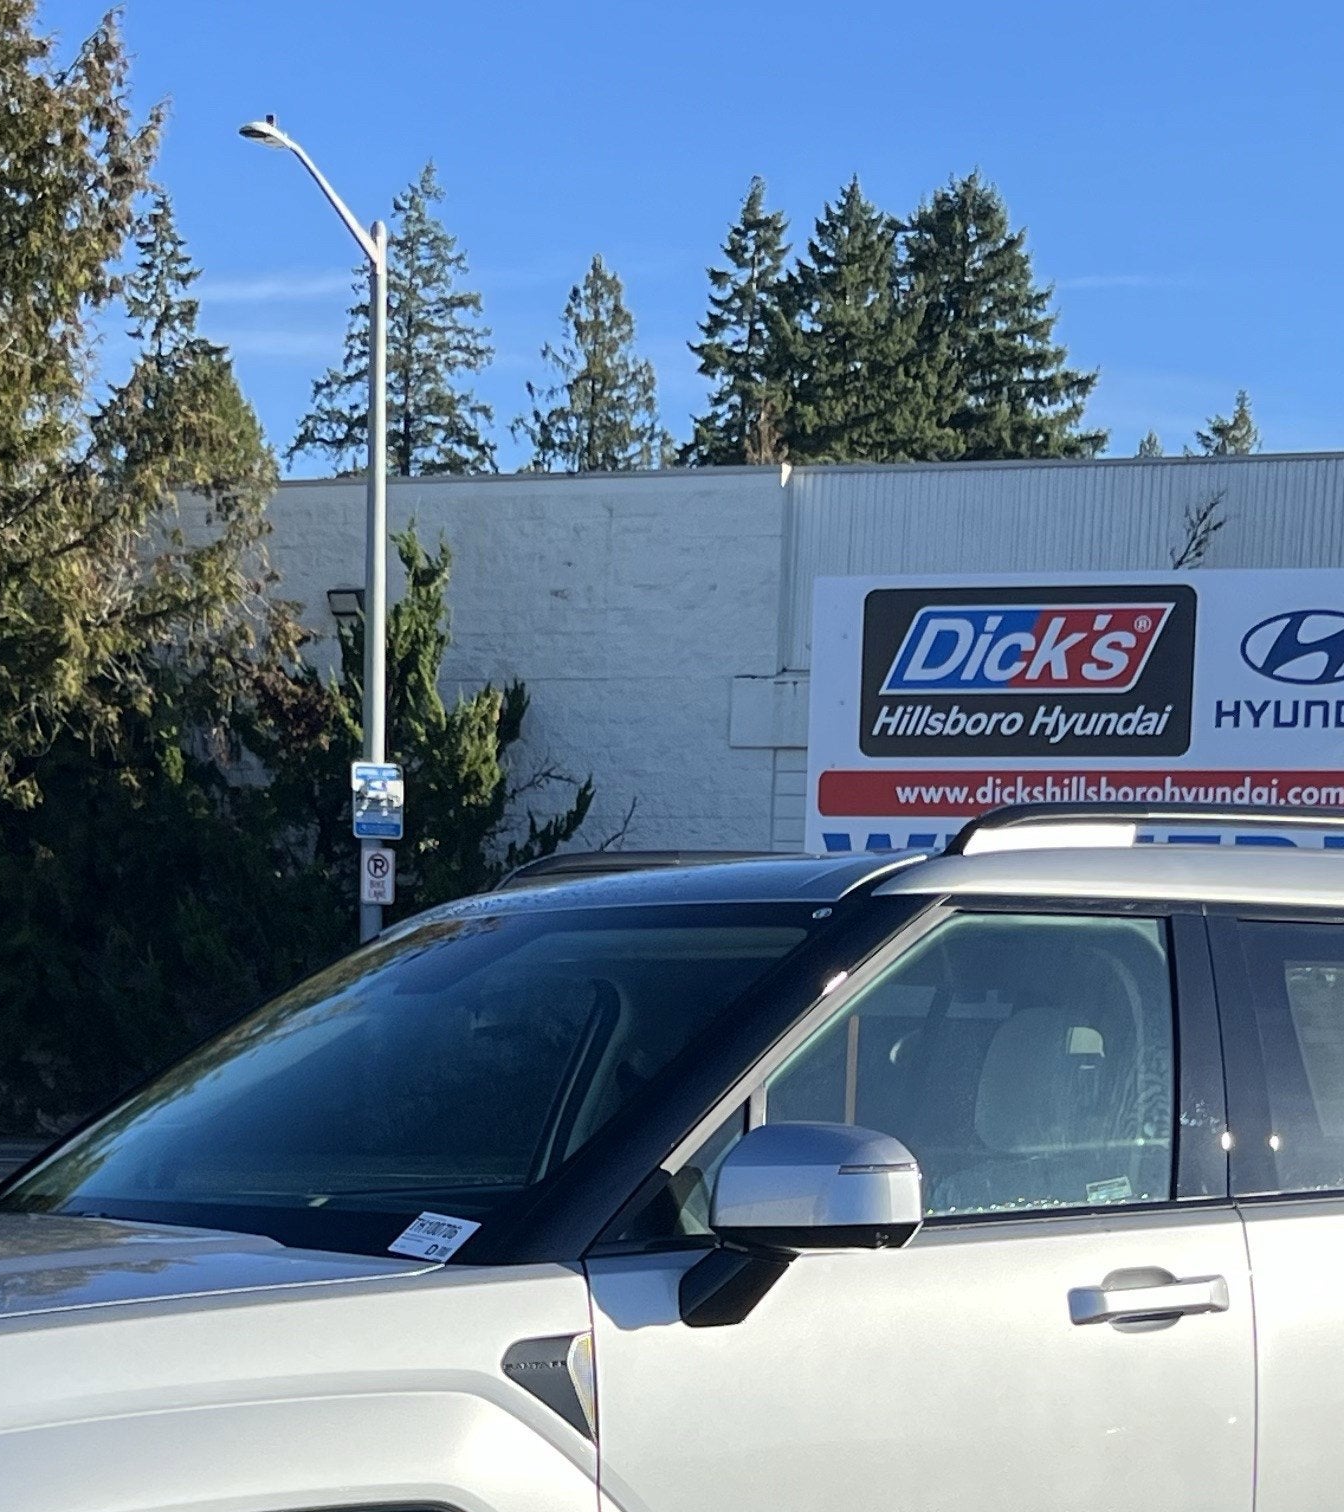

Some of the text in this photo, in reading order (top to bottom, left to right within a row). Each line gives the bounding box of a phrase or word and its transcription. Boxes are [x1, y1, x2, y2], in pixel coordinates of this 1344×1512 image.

[902, 614, 1136, 682] Dick's
[872, 704, 1174, 743] Hillsboro Hyundai
[895, 776, 1344, 805] www.dickshillsborohyundai.com
